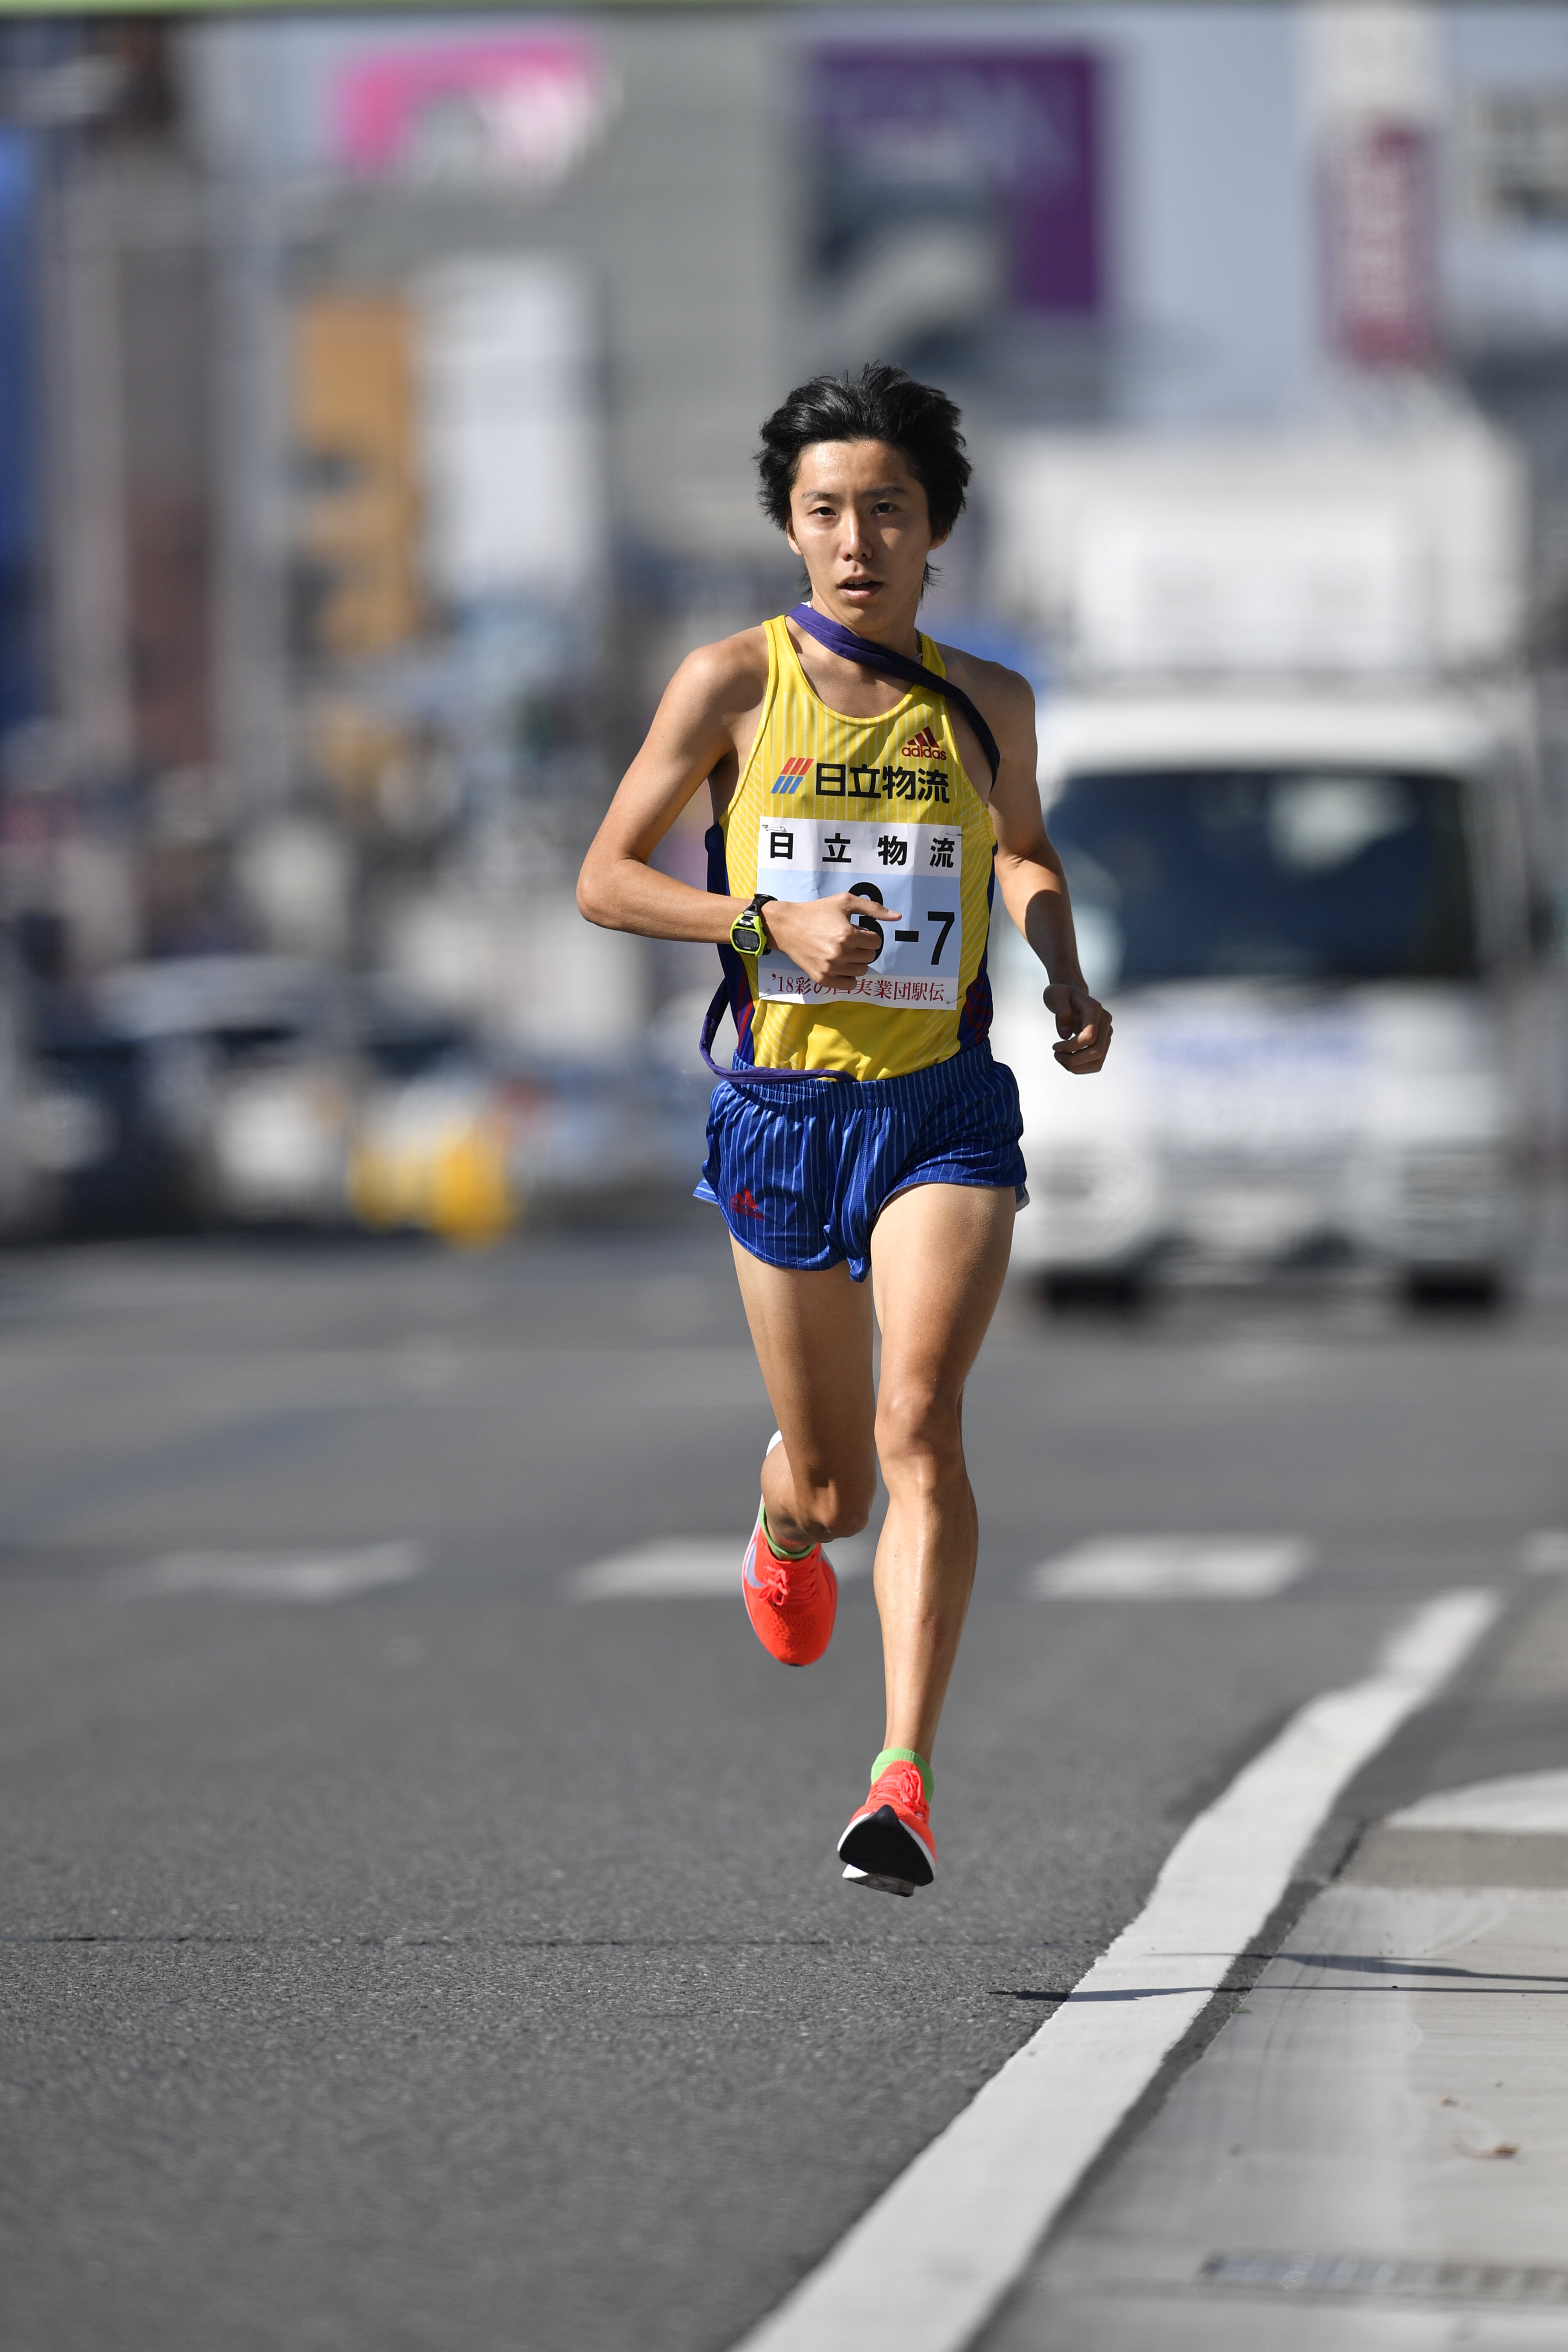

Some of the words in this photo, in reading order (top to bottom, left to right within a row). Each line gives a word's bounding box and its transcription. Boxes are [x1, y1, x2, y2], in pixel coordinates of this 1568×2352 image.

[901, 745, 947, 760] adidas
[816, 763, 950, 803] 日立物流
[770, 832, 955, 868] 日立物流
[772, 973, 945, 1001] '18彩の実業団駅伝
